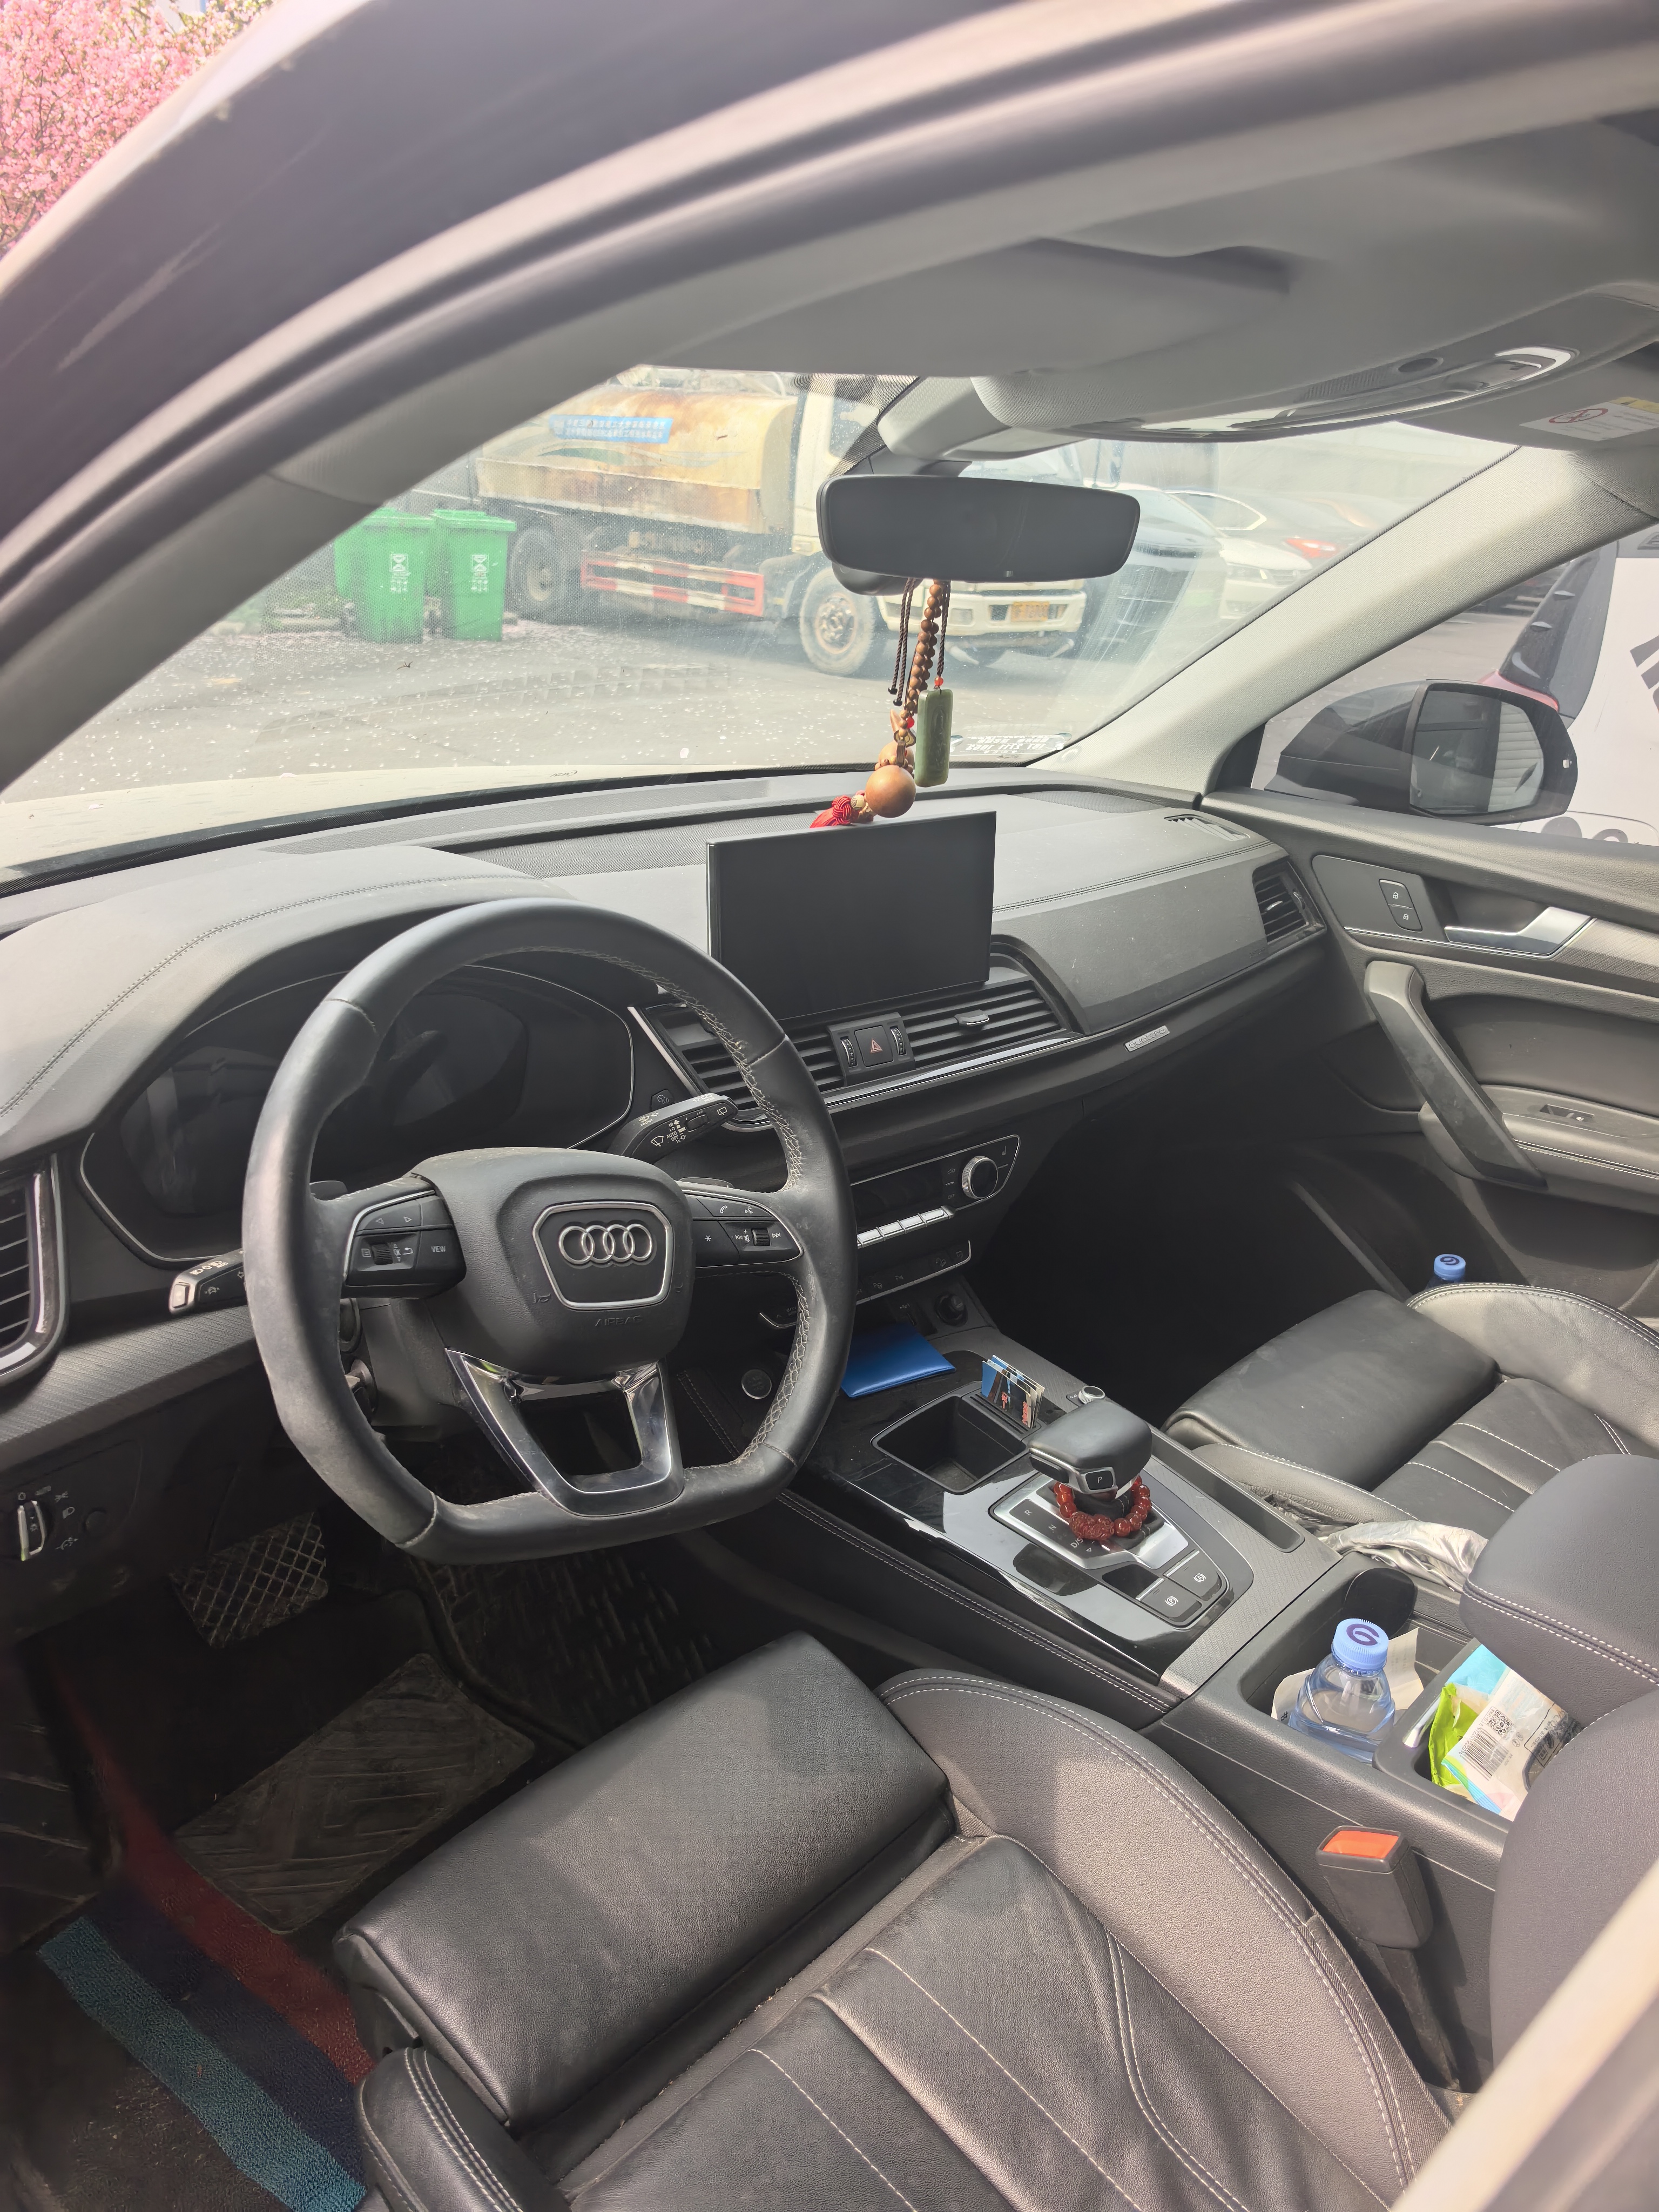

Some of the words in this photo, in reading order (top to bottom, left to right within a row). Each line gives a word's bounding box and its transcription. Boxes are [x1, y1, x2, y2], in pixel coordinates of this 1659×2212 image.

[1129, 1028, 1166, 1048] quattro
[595, 1314, 643, 1327] AIRBAG
[1070, 1537, 1084, 1548] D/S
